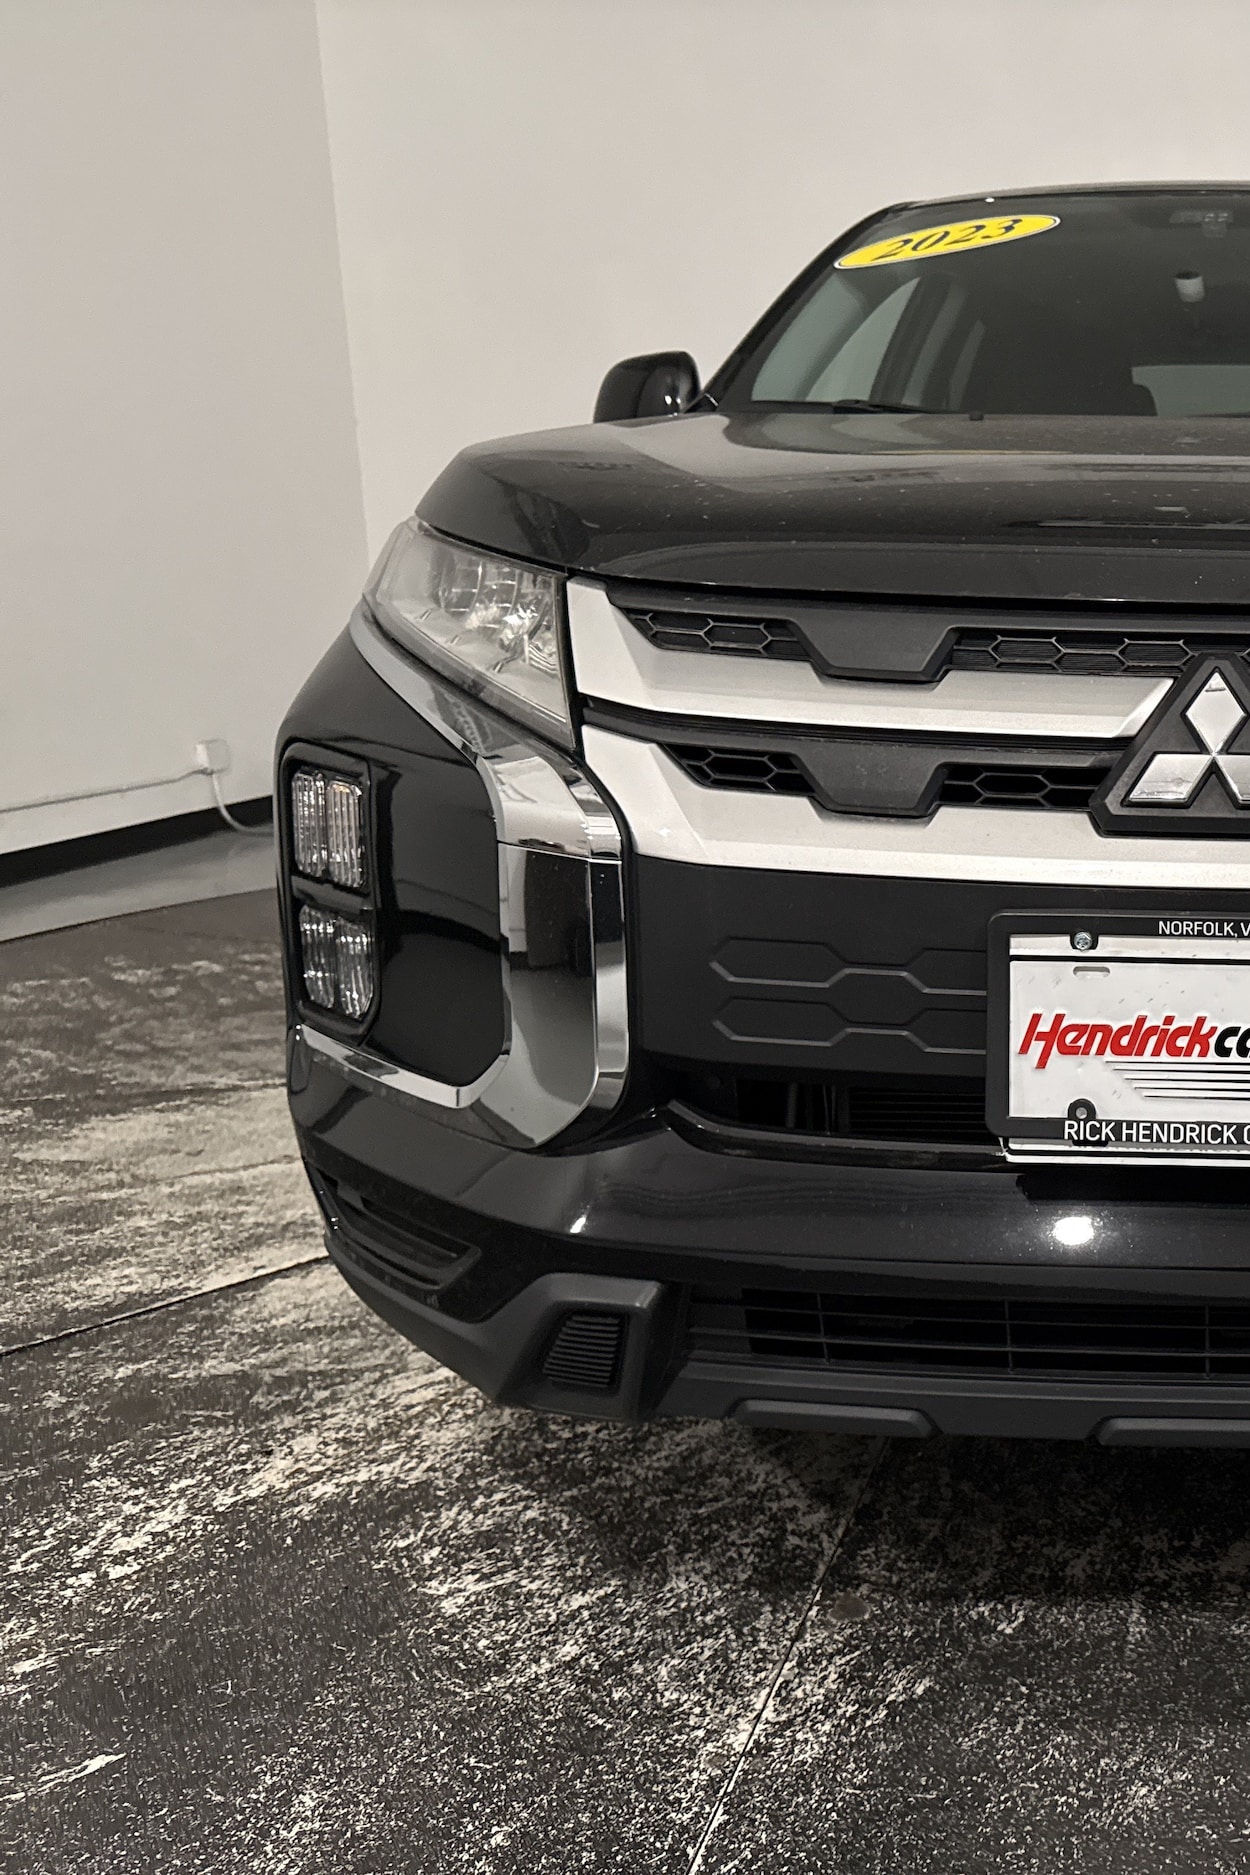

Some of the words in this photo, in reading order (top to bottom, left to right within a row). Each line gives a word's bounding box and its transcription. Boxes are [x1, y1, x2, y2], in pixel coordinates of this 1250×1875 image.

[870, 218, 1023, 261] 2023
[1158, 921, 1238, 938] NORFOLK,
[1064, 1120, 1116, 1142] RICK
[1122, 1122, 1238, 1145] HENDRICK
